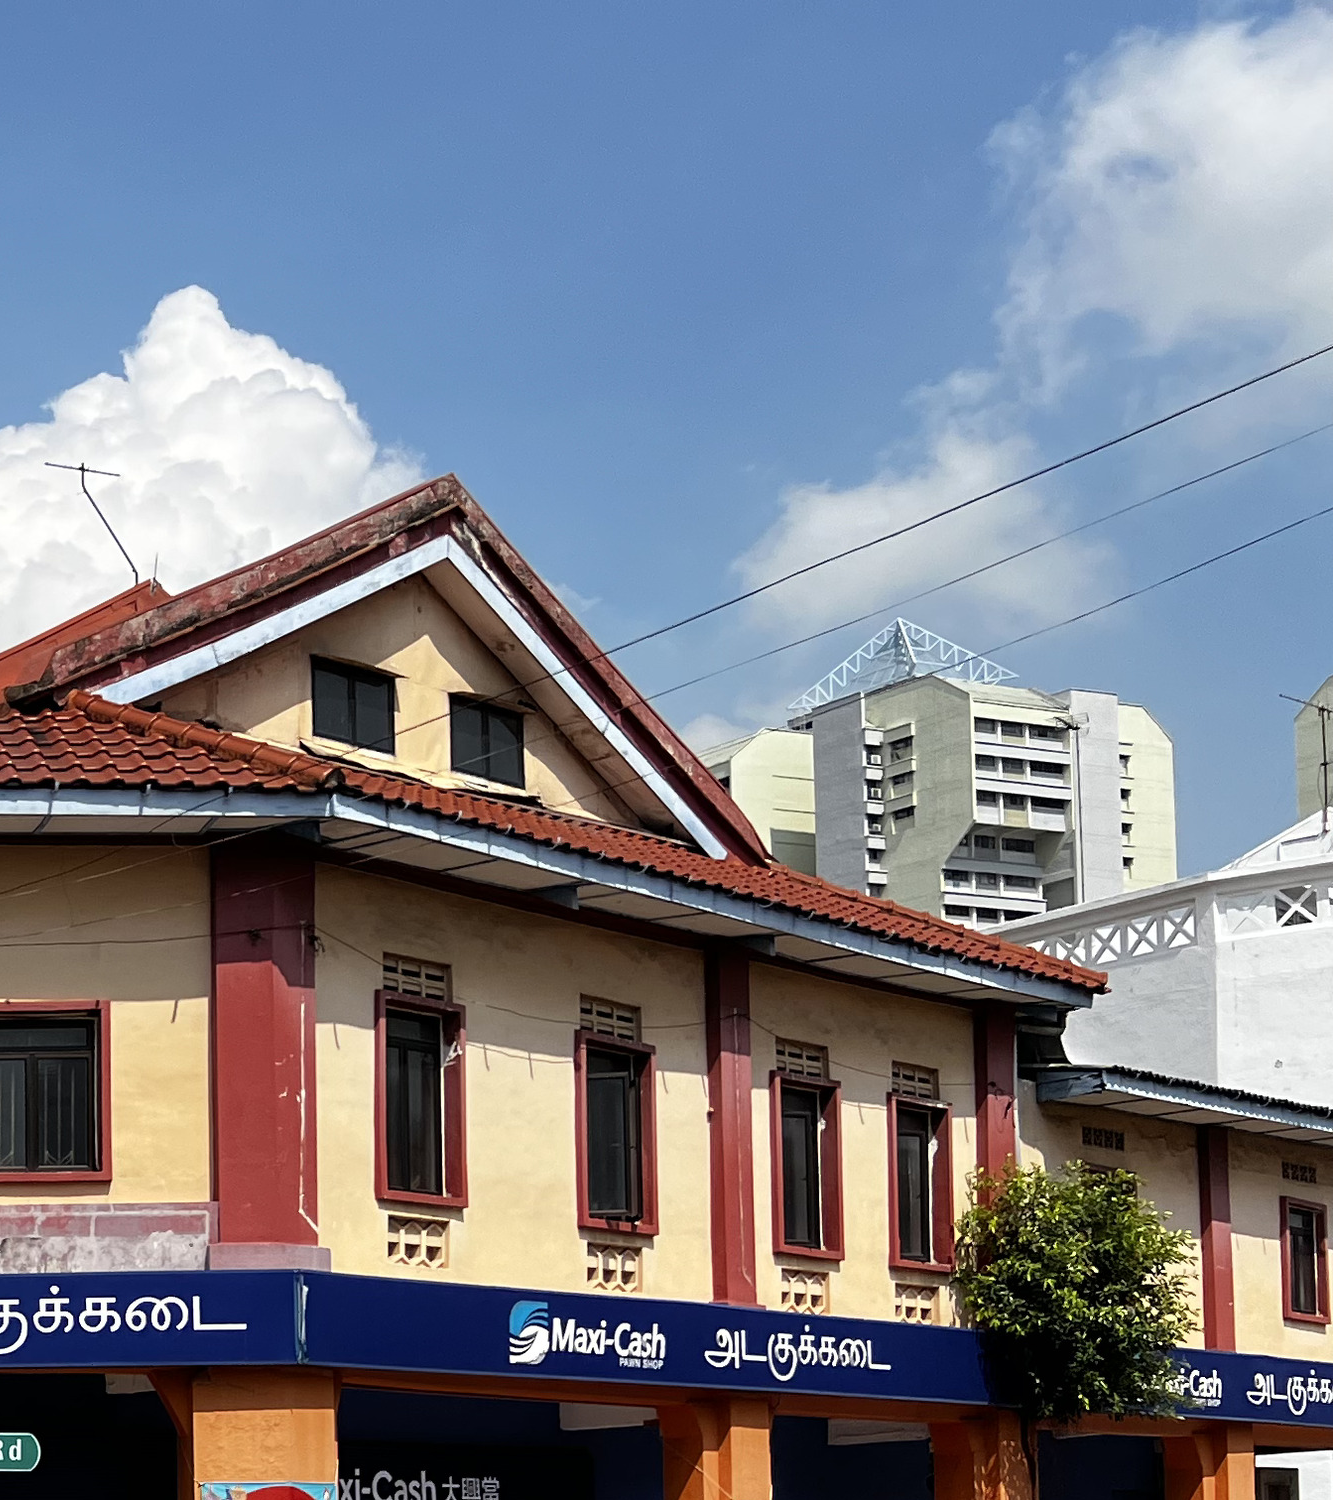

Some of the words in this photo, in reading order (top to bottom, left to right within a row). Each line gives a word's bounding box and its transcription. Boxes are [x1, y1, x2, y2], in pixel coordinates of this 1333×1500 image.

[551, 1317, 667, 1359] Maxi-Cash
[704, 1324, 892, 1382] அடகுக்கடை
[642, 1358, 664, 1370] SHOP
